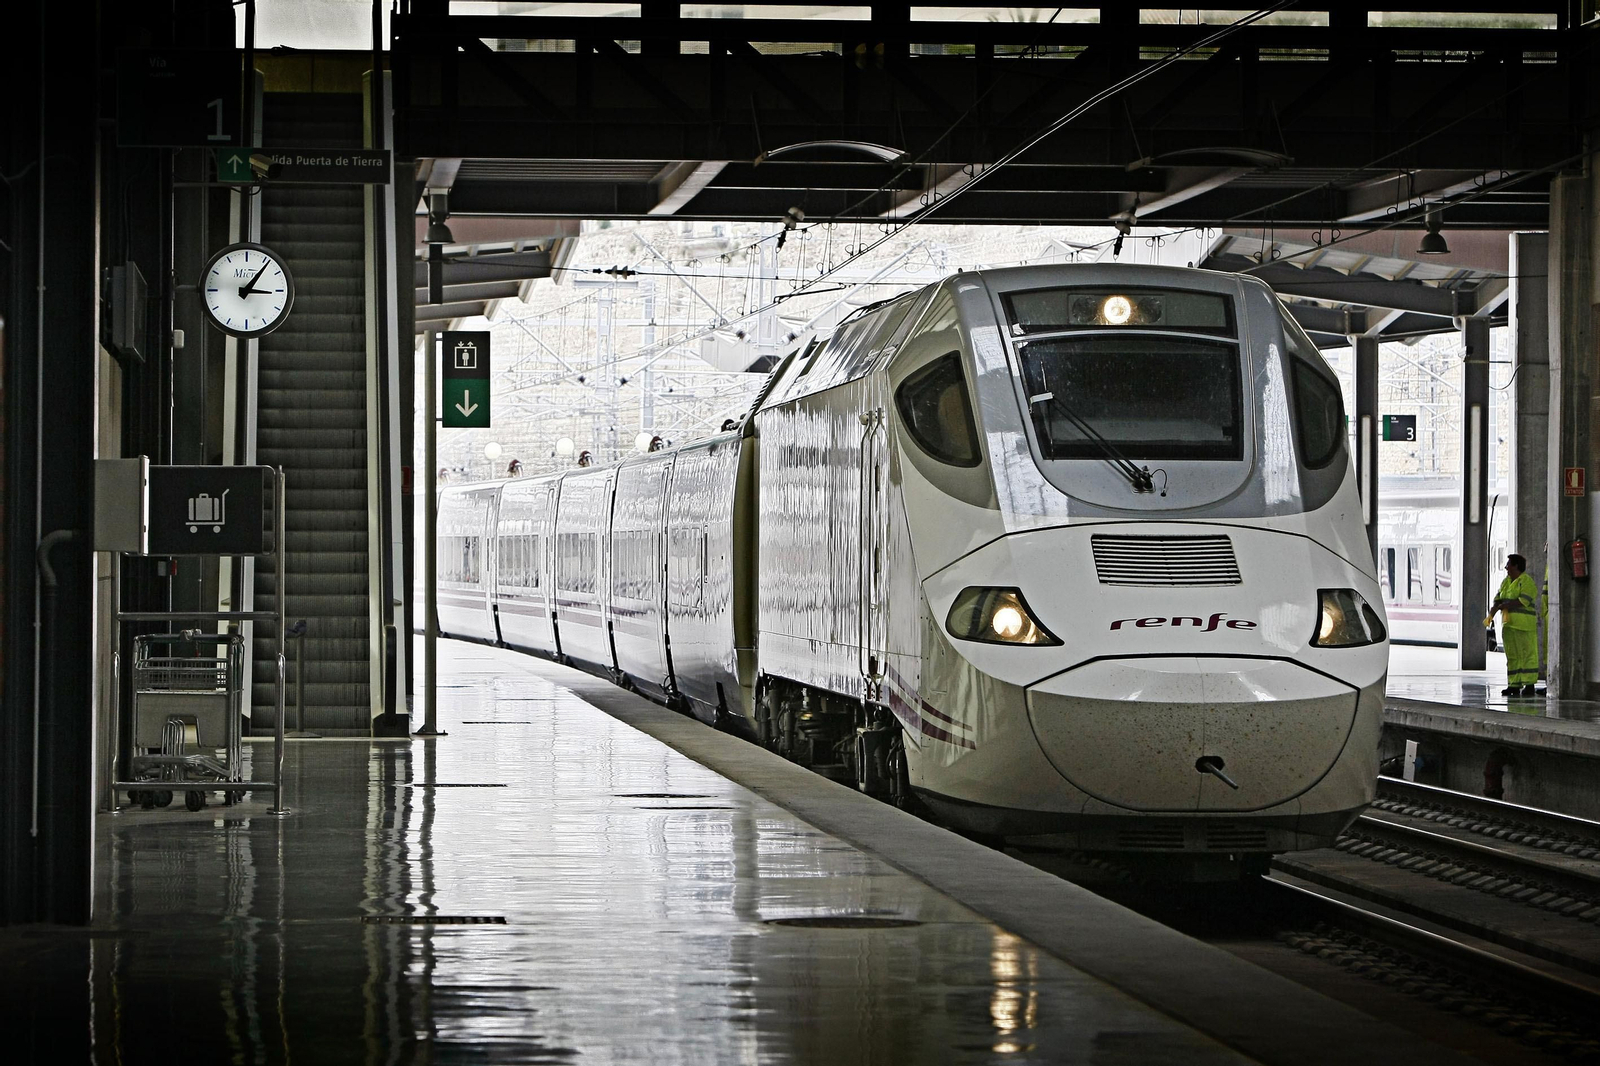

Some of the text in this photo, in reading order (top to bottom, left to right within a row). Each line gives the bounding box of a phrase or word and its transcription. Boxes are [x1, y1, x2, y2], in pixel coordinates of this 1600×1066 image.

[206, 98, 232, 141] 1
[271, 154, 383, 167] lida Puerta de Tierra
[233, 268, 255, 279] Micr
[1406, 427, 1414, 441] 3
[1109, 611, 1258, 633] renfe
